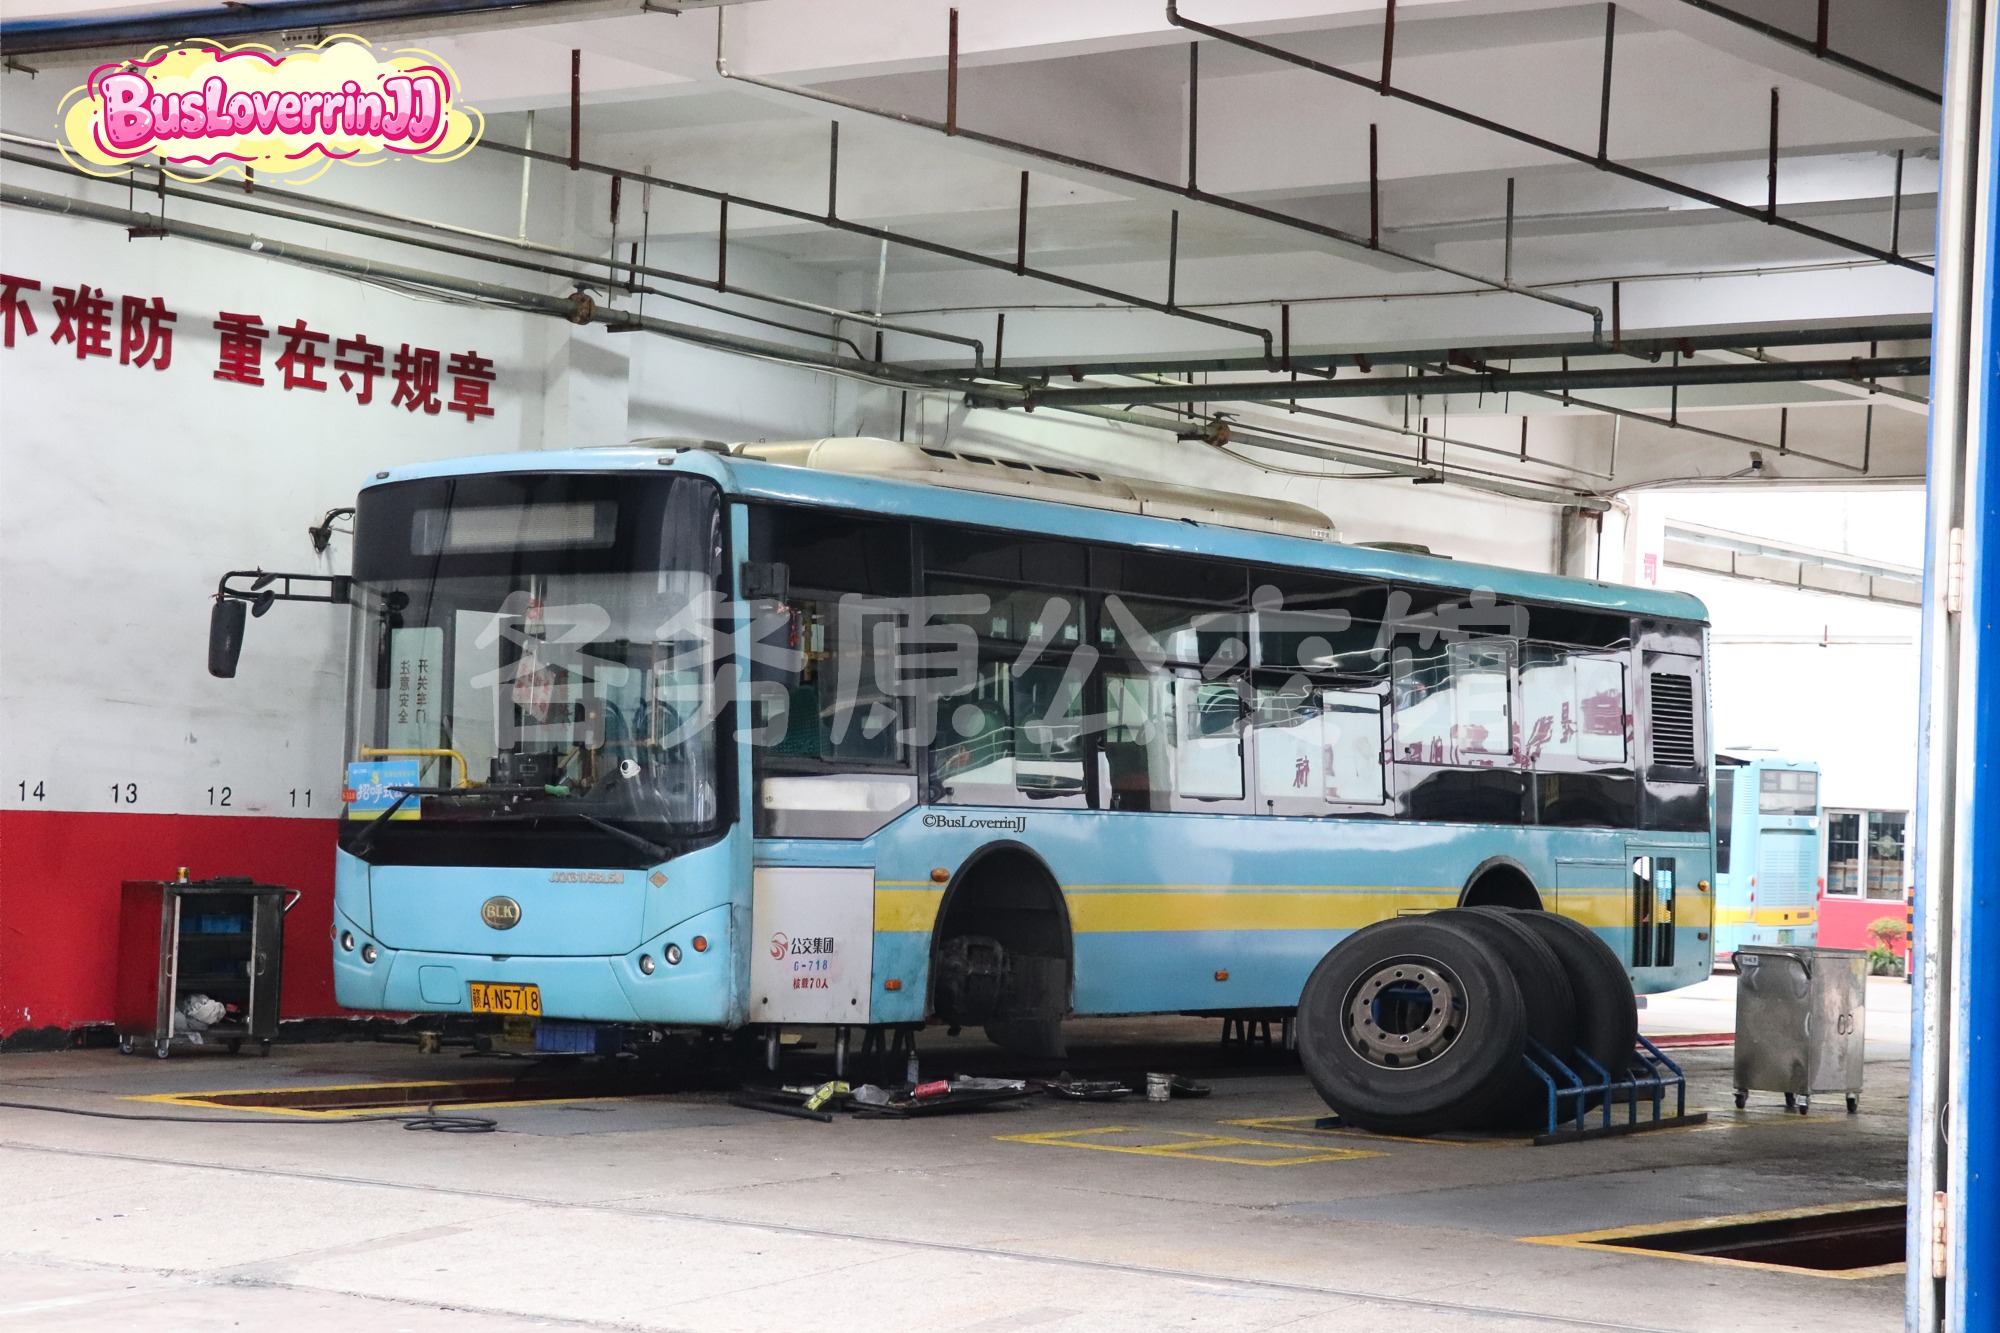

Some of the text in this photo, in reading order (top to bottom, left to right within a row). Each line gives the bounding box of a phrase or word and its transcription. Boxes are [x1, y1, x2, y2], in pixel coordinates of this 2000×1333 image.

[0, 273, 497, 421] 不难防 重在守规章
[18, 781, 46, 802] 14
[111, 783, 138, 804] 13
[207, 787, 232, 807] 12
[289, 789, 313, 808] 11
[486, 904, 516, 919] BLK
[791, 937, 834, 954] 公交集团
